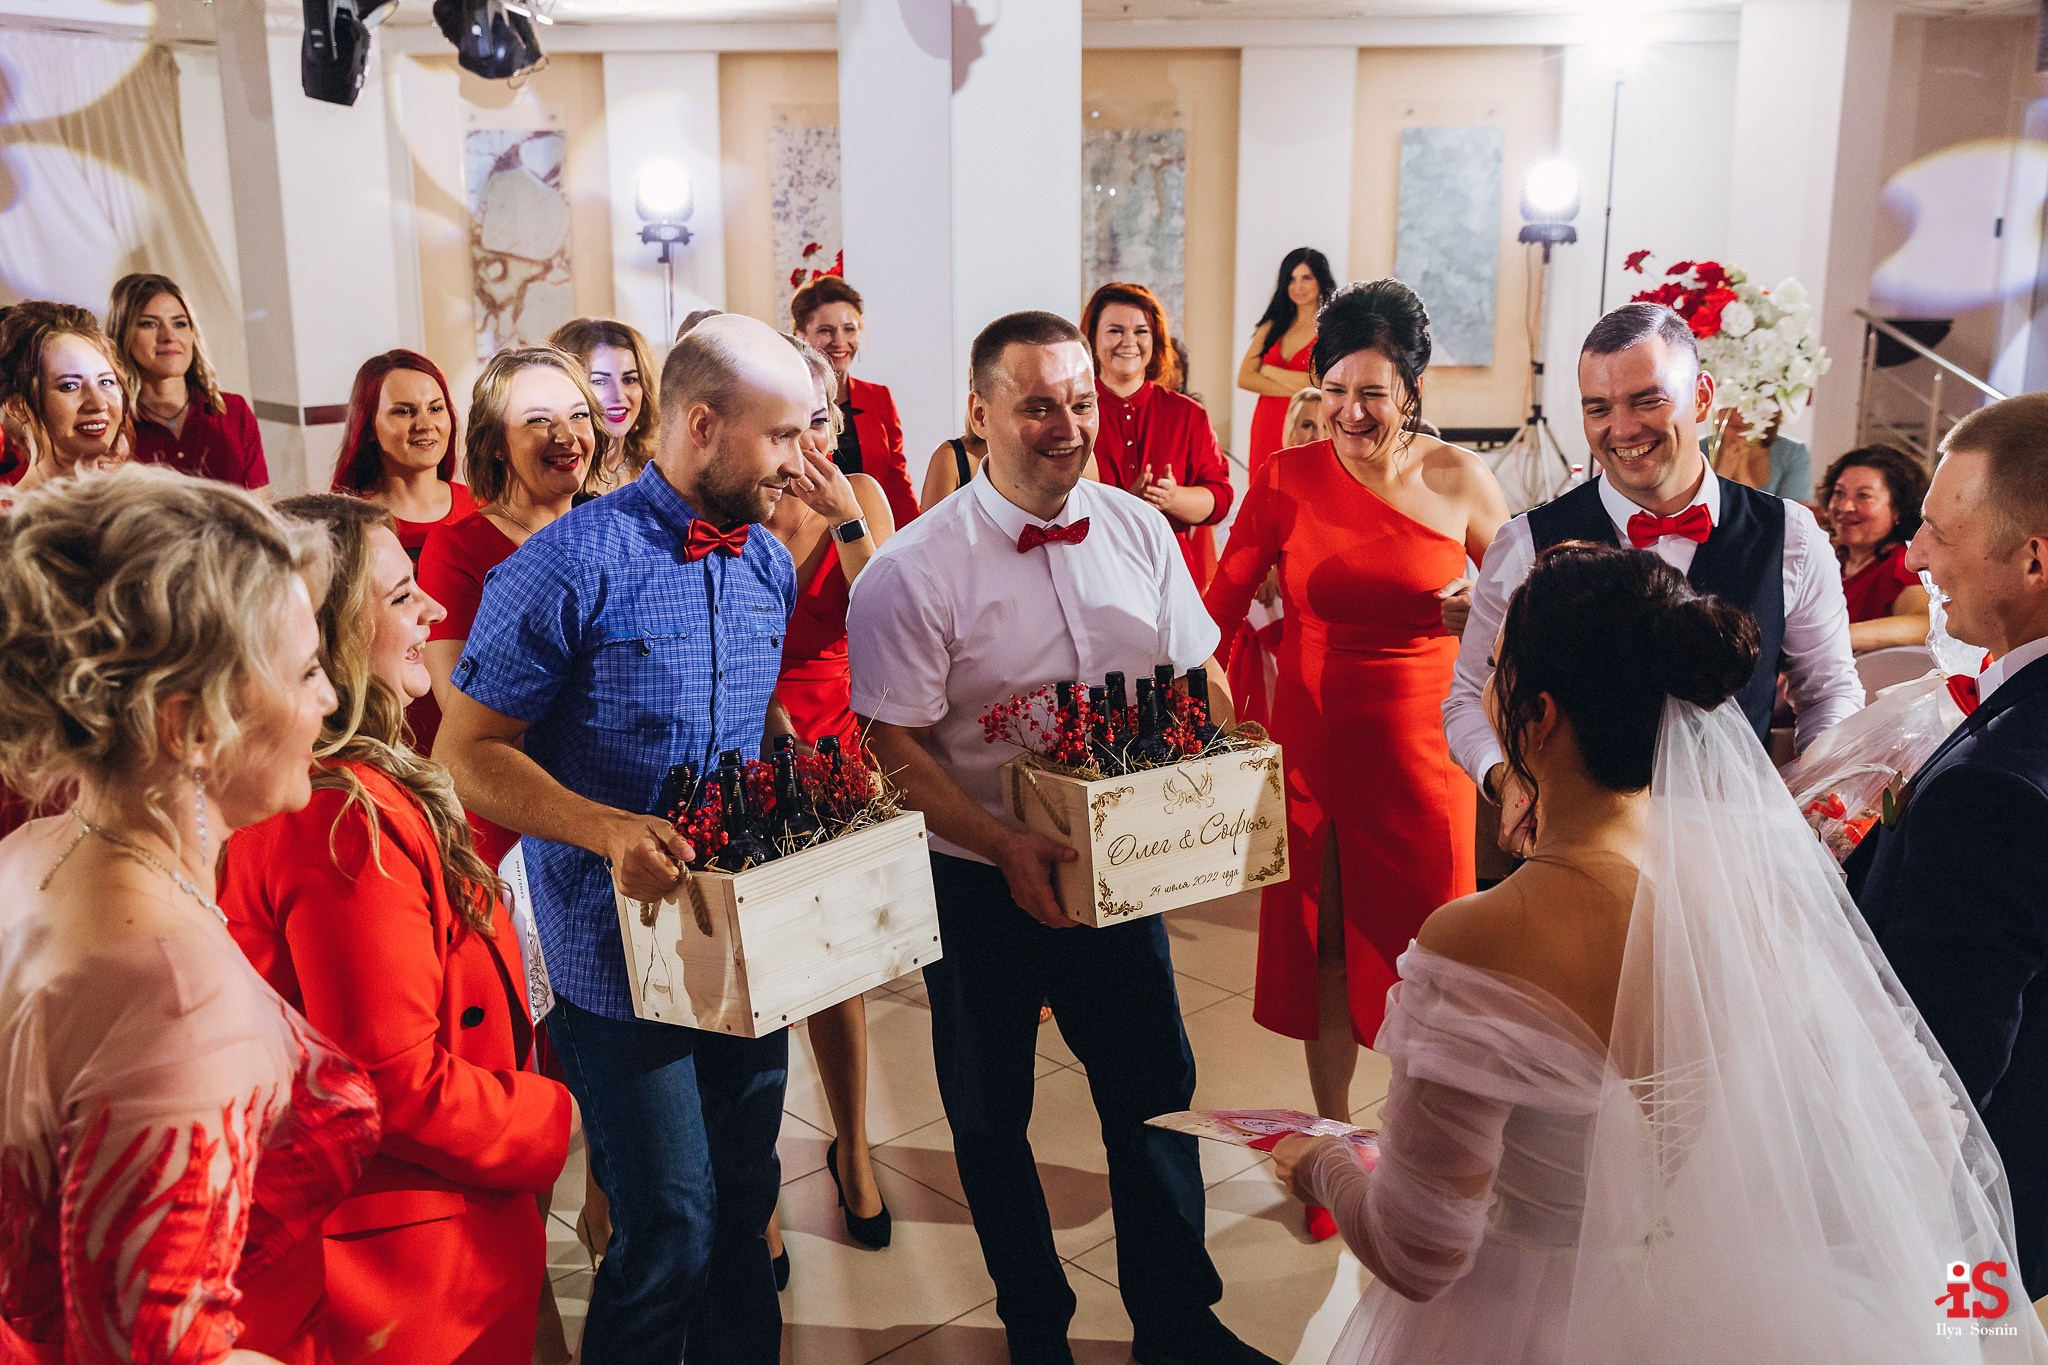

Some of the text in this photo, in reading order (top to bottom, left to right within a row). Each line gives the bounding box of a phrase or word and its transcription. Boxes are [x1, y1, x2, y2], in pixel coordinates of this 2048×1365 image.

[1107, 808, 1272, 866] Олег & Софья
[1149, 884, 1162, 897] 29
[1192, 871, 1219, 887] 2022
[1222, 868, 1241, 888] года
